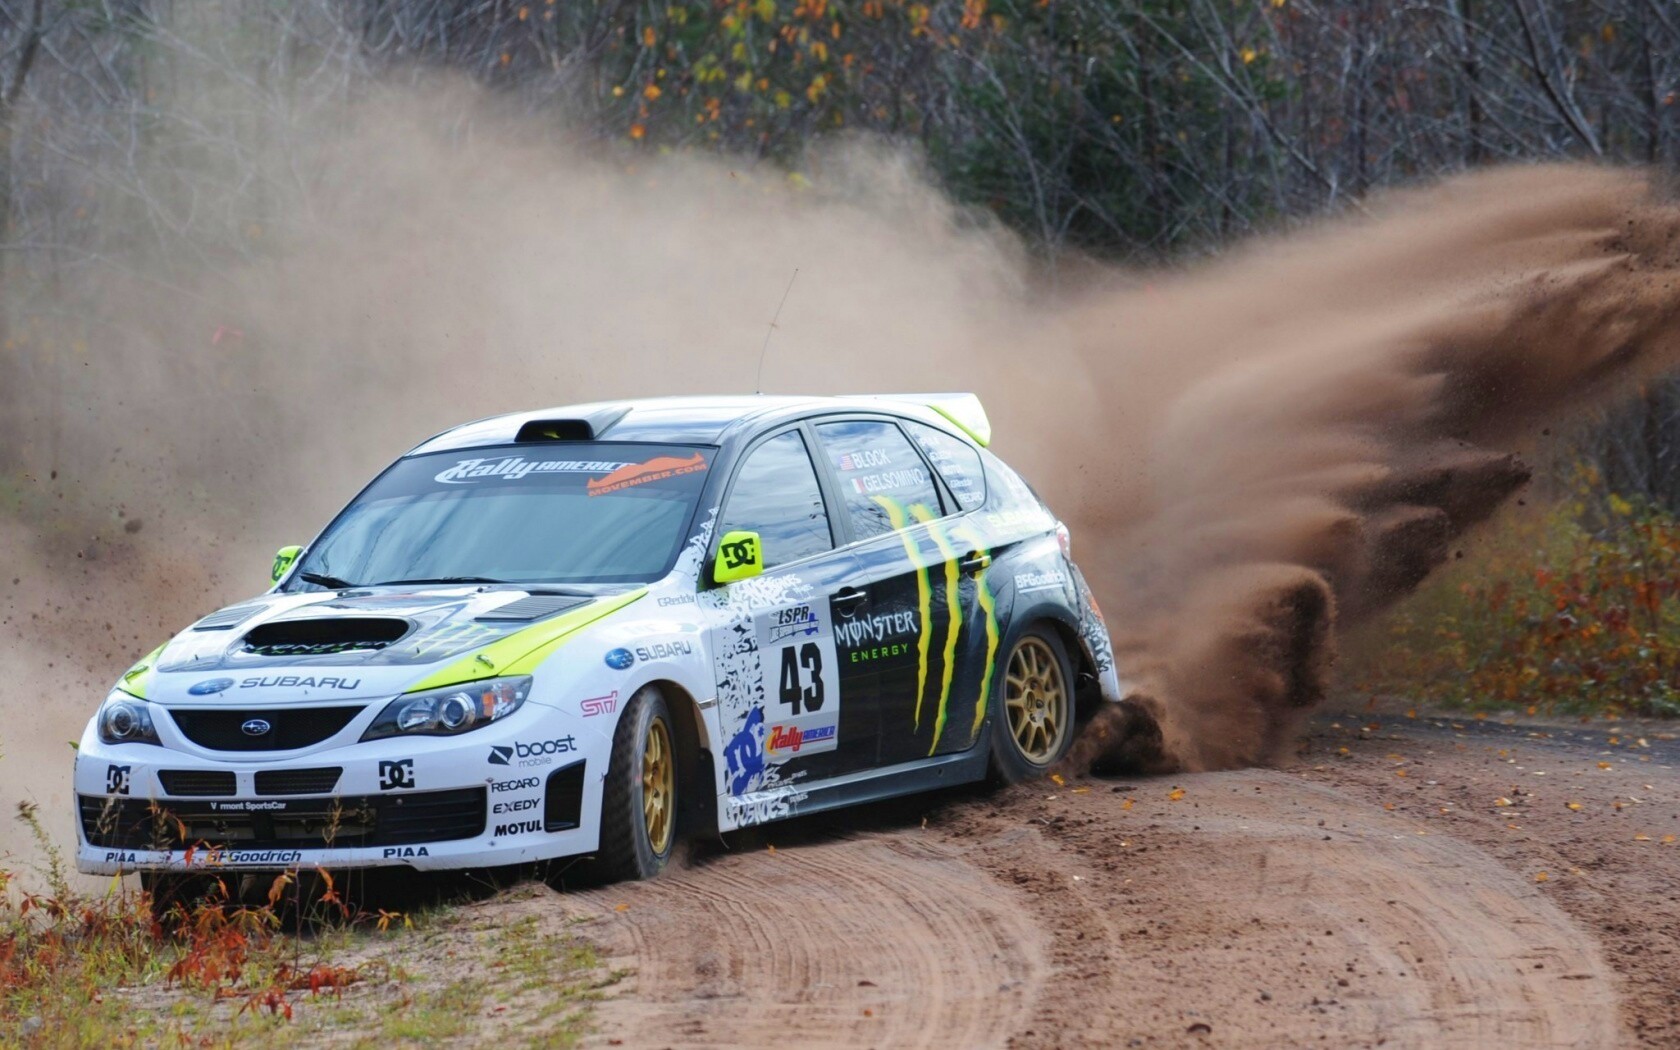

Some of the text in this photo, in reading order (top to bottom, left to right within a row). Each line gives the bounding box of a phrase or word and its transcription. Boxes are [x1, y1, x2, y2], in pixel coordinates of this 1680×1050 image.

[534, 461, 637, 472] AMERIC
[851, 449, 891, 469] BLOCK
[588, 464, 707, 497] MOVEMBER.COM
[862, 468, 924, 492] GELSOMINO
[721, 538, 756, 569] DC
[778, 606, 809, 625] LSPR
[636, 641, 692, 662] SUBARU
[851, 643, 908, 663] ENERGY
[240, 676, 361, 690] SUBARU
[778, 642, 825, 716] 43
[515, 734, 577, 759] boost
[770, 725, 804, 752] Rally
[518, 756, 552, 768] mobile
[378, 758, 415, 791] DC
[491, 776, 540, 793] RECARO
[245, 802, 287, 811] SportsCar
[493, 798, 541, 814] EXEDY
[494, 820, 542, 837] MOTUL
[106, 852, 136, 863] PIAA
[384, 846, 429, 858] PIAA
